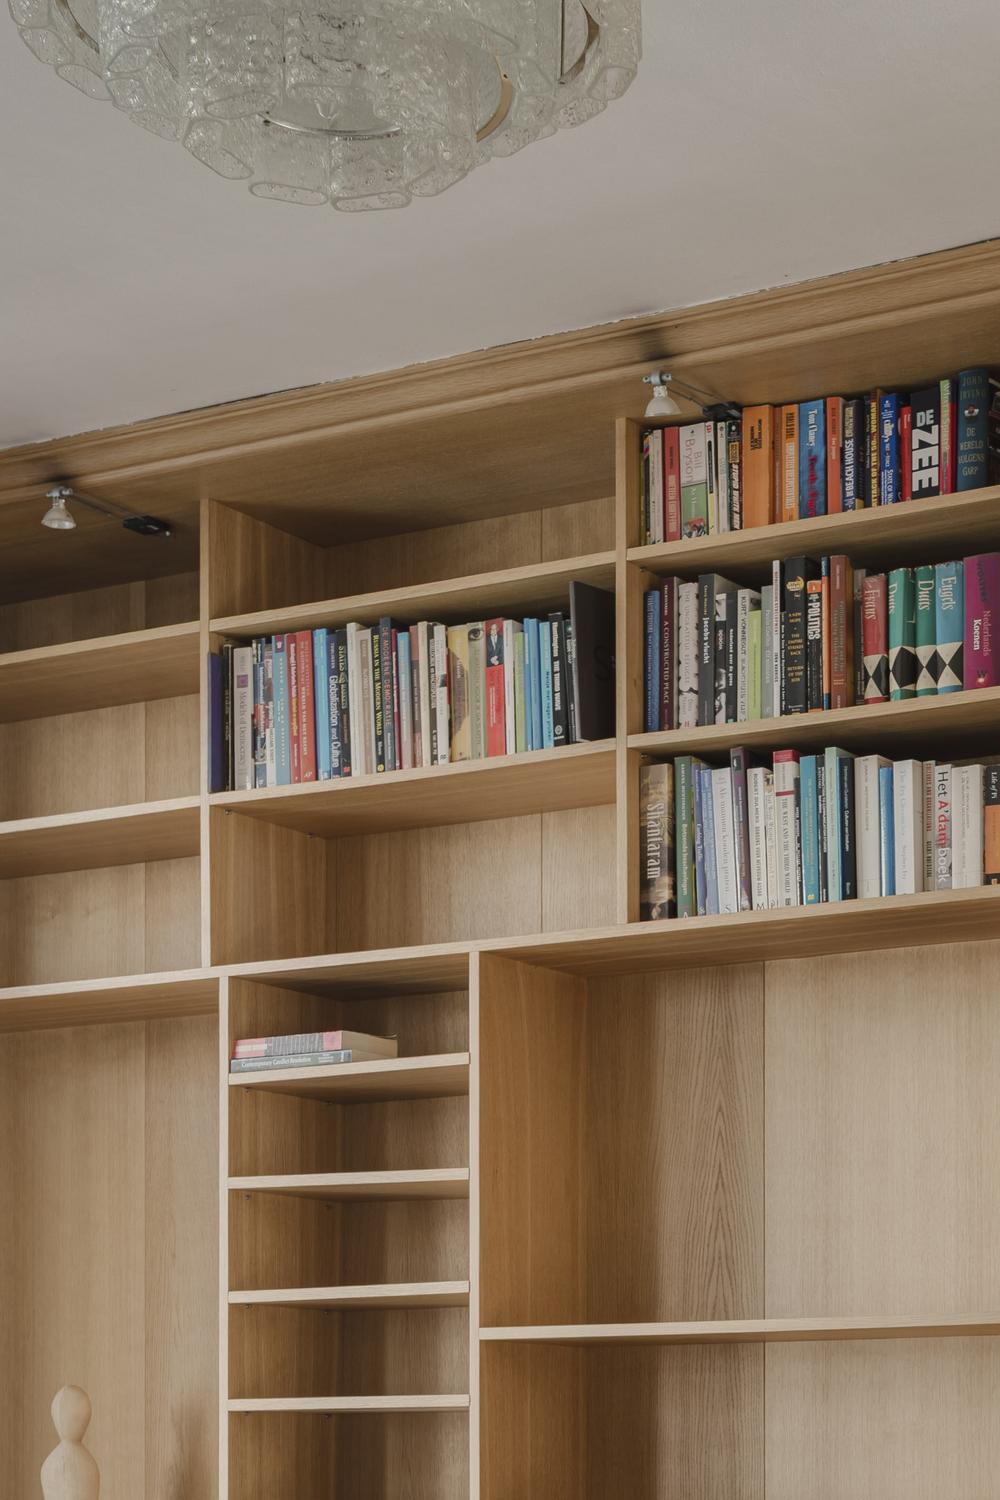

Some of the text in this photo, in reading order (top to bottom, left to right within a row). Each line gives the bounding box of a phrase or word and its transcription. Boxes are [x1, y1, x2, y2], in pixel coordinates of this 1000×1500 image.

[916, 408, 935, 428] DE
[966, 428, 976, 437] DE
[684, 438, 696, 484] Bryson
[694, 451, 702, 468] Bill
[845, 438, 854, 464] HOUSE
[912, 424, 938, 492] ZEE
[845, 466, 854, 490] BEACH
[864, 588, 880, 620] Frans
[918, 579, 934, 611] Duits
[938, 576, 957, 610] Engels
[808, 602, 820, 640] POLITICS
[972, 619, 982, 650] Koenen
[982, 610, 992, 656] Nederlands
[329, 675, 340, 726] Globalization
[332, 742, 341, 768] Culture
[938, 772, 949, 797] Het
[646, 802, 665, 879] Shantaram
